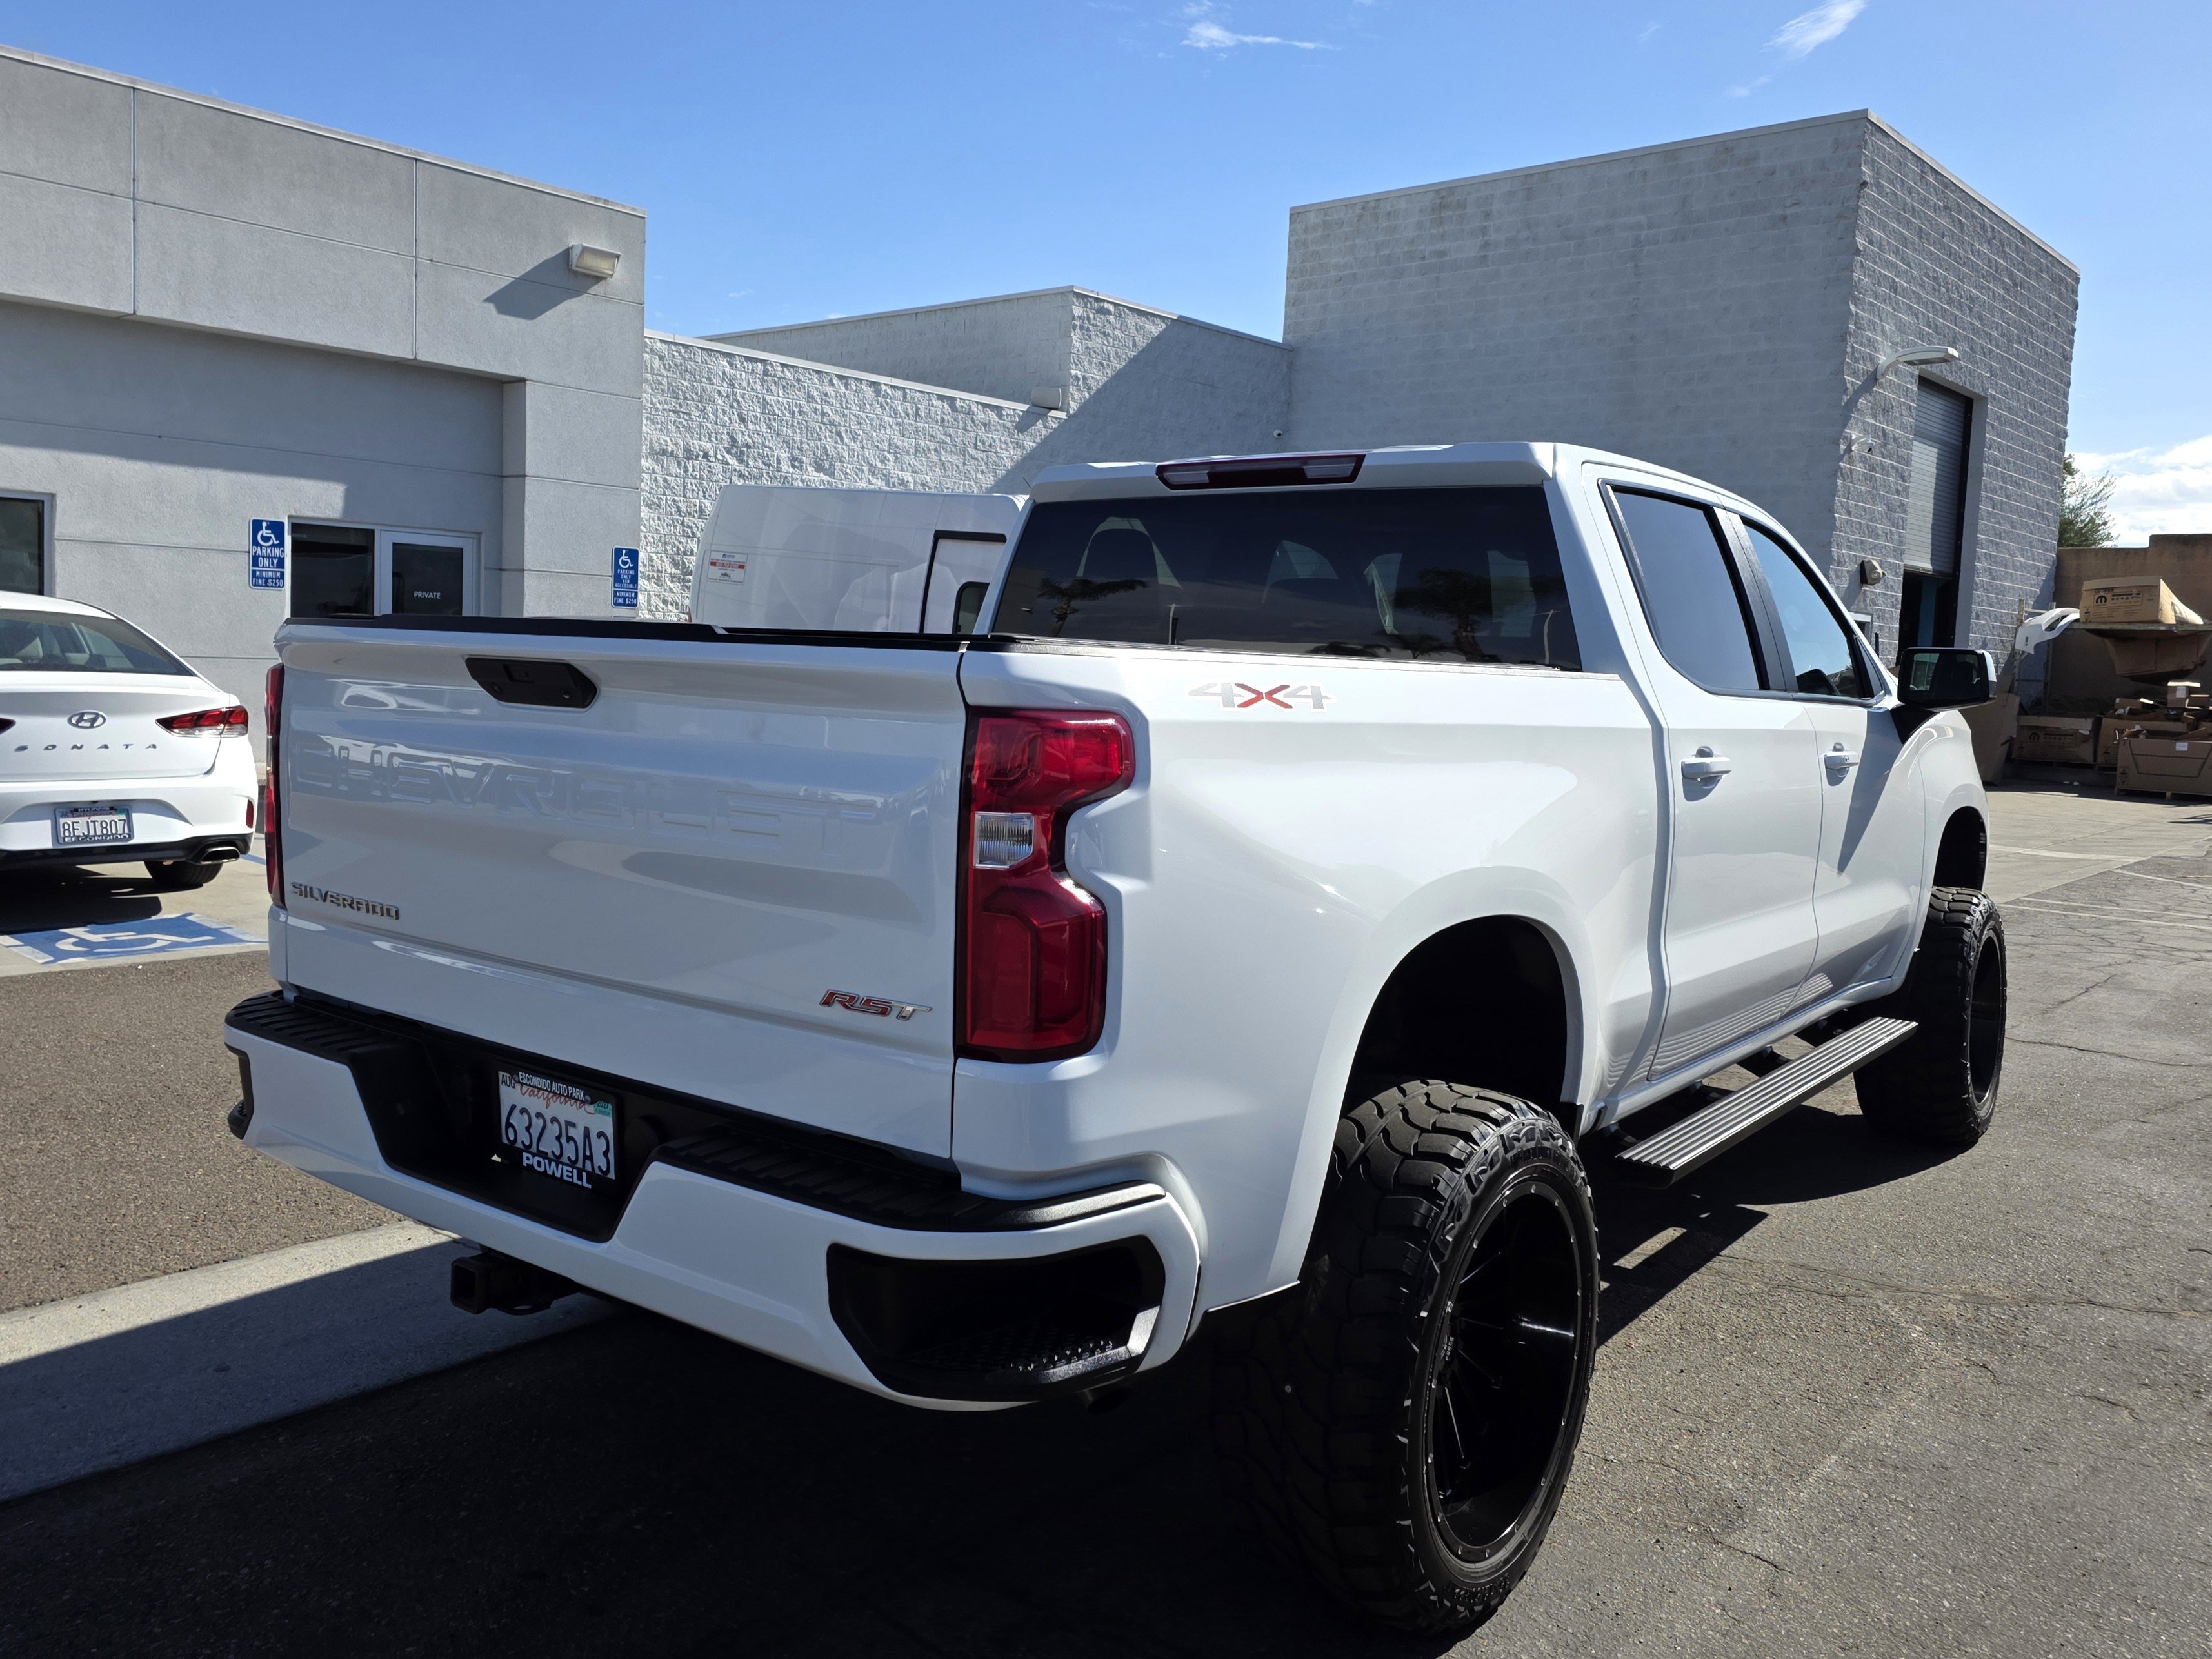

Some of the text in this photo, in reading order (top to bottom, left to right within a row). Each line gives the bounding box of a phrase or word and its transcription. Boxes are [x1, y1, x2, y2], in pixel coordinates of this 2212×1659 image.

[252, 546, 284, 558] PARKING
[258, 557, 278, 568] ONLY
[414, 591, 441, 599] PRIVATE
[14, 743, 157, 752] SONATA
[62, 819, 126, 837] 8EJT807
[290, 881, 399, 920] SILVERADO
[819, 989, 933, 1021] RST
[501, 1074, 515, 1089] AUG
[519, 1071, 585, 1101] ESCONDIDO AUTO PARK
[504, 1103, 611, 1176] 63235A3
[522, 1152, 592, 1189] POWELL
